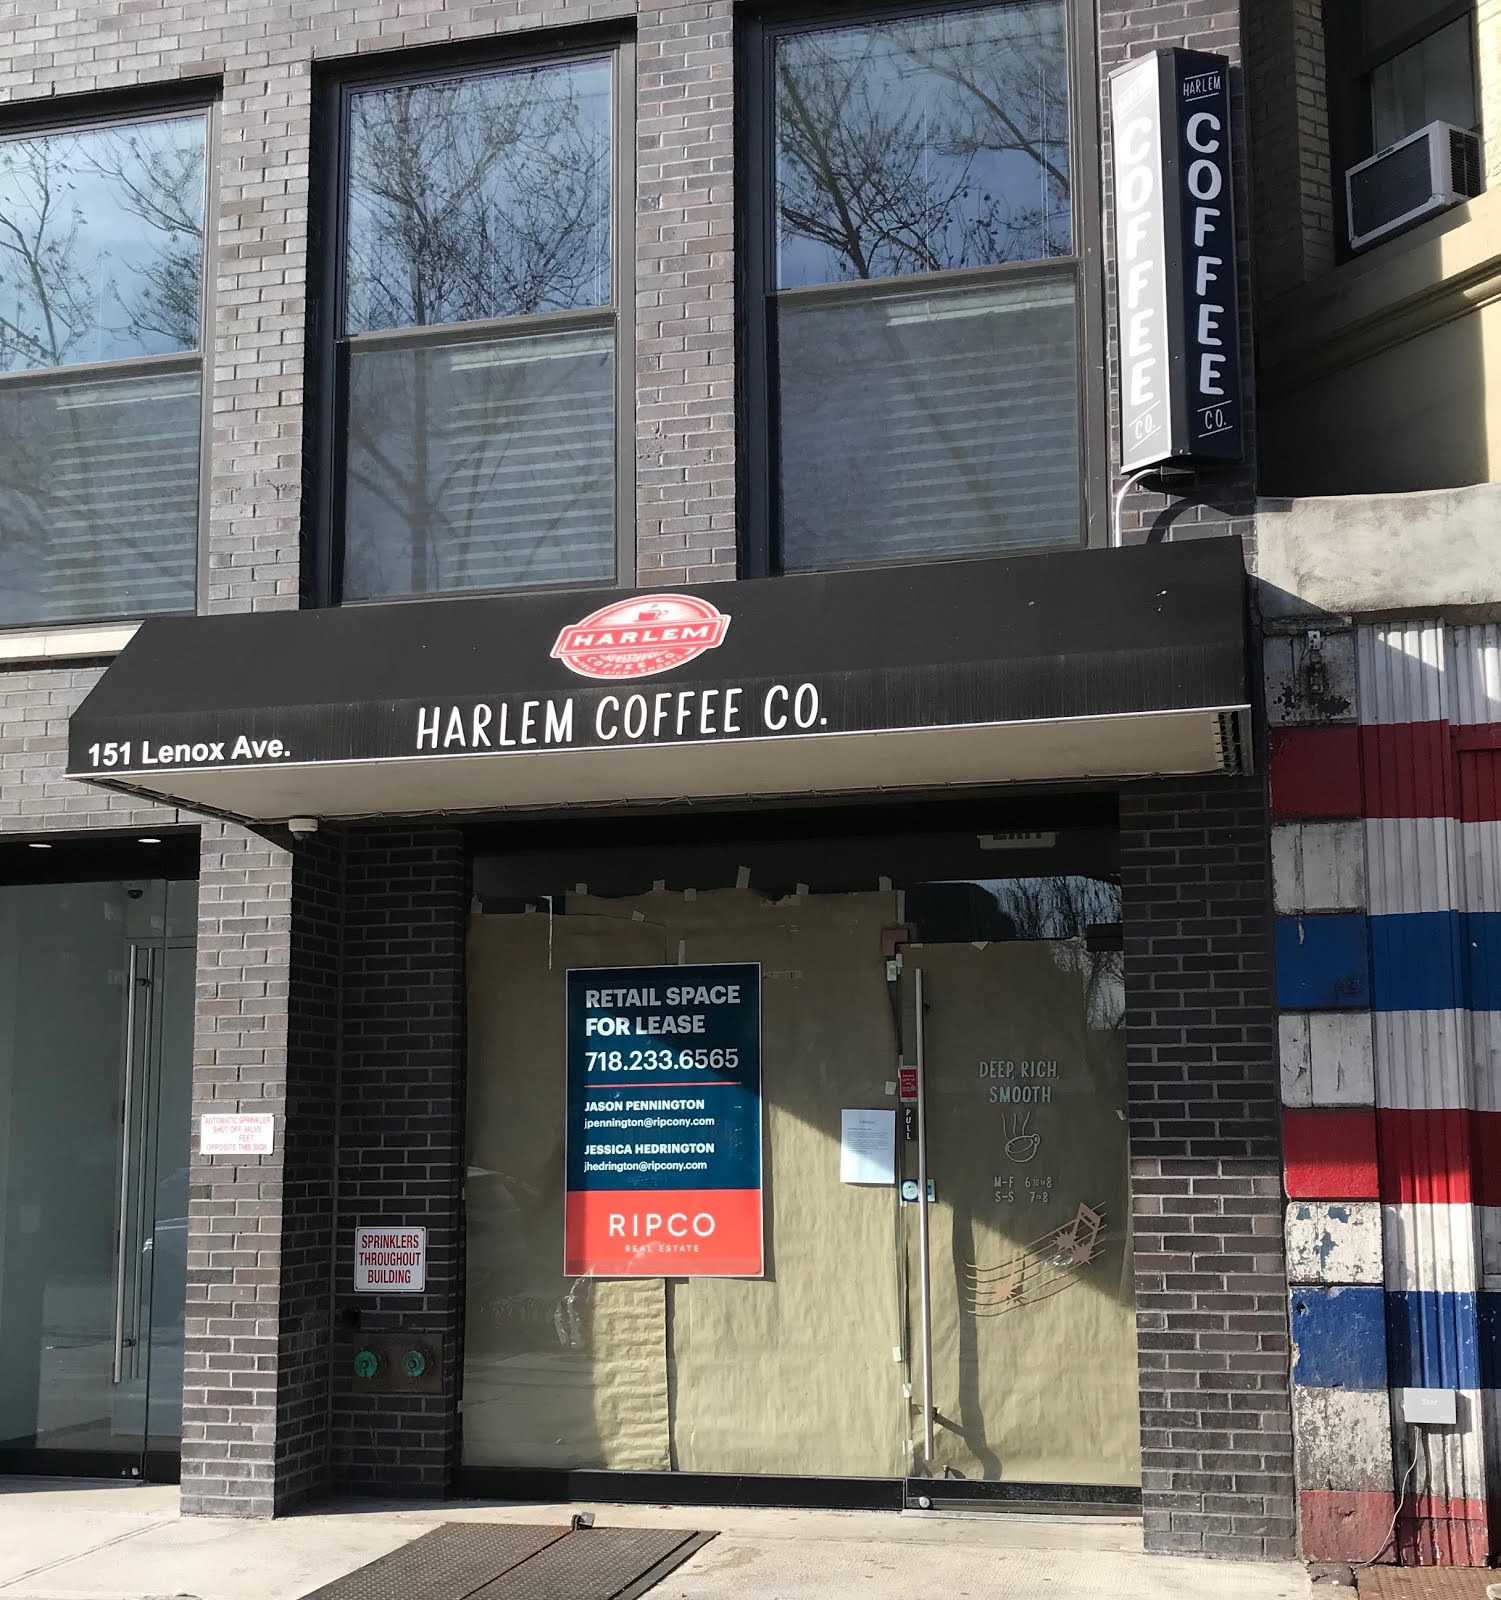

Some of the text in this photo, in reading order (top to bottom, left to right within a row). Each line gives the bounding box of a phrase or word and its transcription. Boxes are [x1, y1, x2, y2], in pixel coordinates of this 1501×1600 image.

[1183, 75, 1221, 97] HARLEM
[1120, 116, 1156, 407] COFFEE
[1186, 112, 1227, 396] COFFEE
[1205, 409, 1227, 430] CO.
[571, 625, 710, 647] HARLEM
[587, 656, 647, 671] COFFEE
[416, 682, 828, 750] HARLEM COFFEE CO.
[88, 735, 291, 767] 151 Lenox Ave.
[585, 984, 741, 1009] RETAIL SPACE
[585, 1014, 706, 1037] FOR LEASE
[584, 1048, 739, 1072] 718.233.6565
[979, 1061, 1015, 1080] DEEP,
[989, 1086, 1052, 1103] SMOOTH
[584, 1099, 705, 1112] JASON PENNINGTON
[239, 1116, 271, 1124] SPRINKLER
[584, 1117, 715, 1129] jpennington@ripcony.com
[584, 1143, 715, 1155] JESSICA HEDRINGTON
[584, 1160, 708, 1173] jhedrington@ripcony.com
[609, 1213, 716, 1237] RIPCO
[361, 1234, 419, 1249] SPRINKLERS
[625, 1244, 700, 1253] REAL ESTATE
[359, 1252, 421, 1266] THROUGHOUT
[367, 1269, 411, 1284] BUILDING
